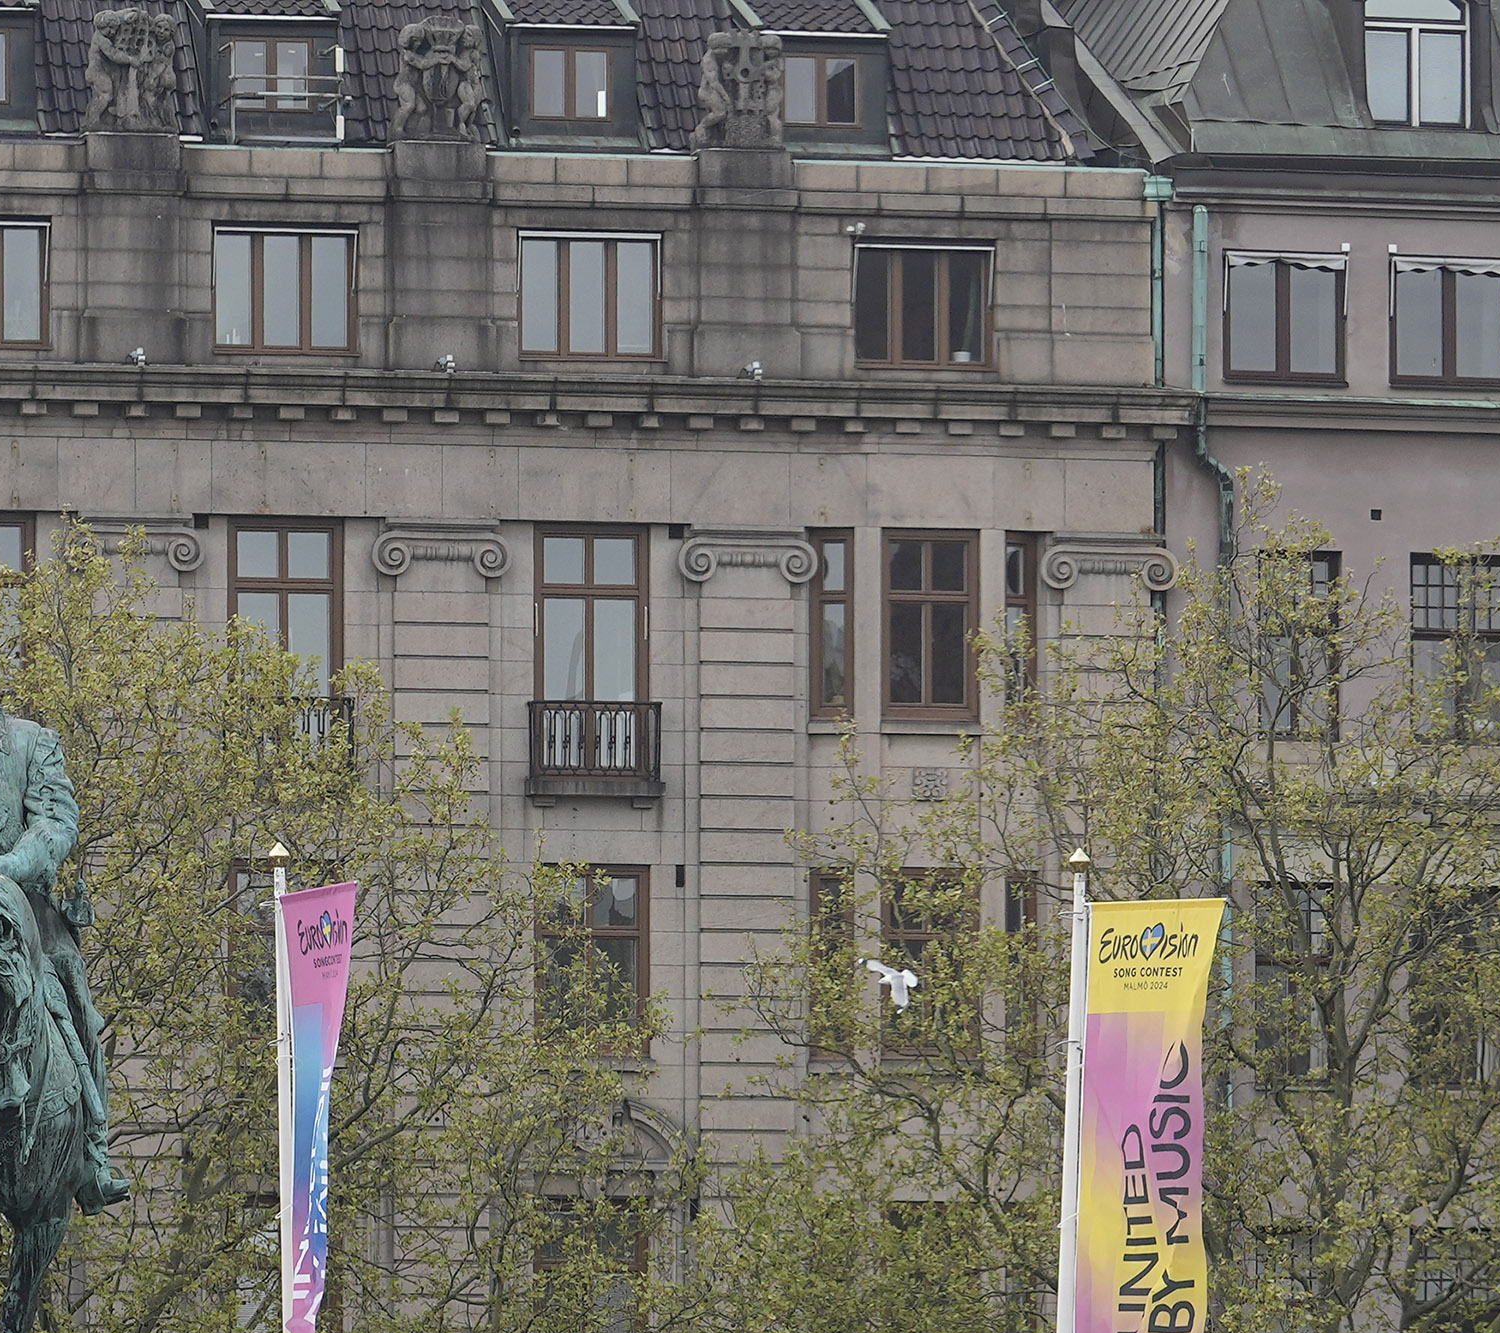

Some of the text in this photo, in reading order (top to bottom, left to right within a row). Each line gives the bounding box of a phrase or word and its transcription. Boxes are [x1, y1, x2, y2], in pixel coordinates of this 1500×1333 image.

[1113, 966, 1184, 979] SONG CONTEST
[1123, 981, 1168, 991] MALMÖ 2024
[1148, 1039, 1192, 1244] MUSIC
